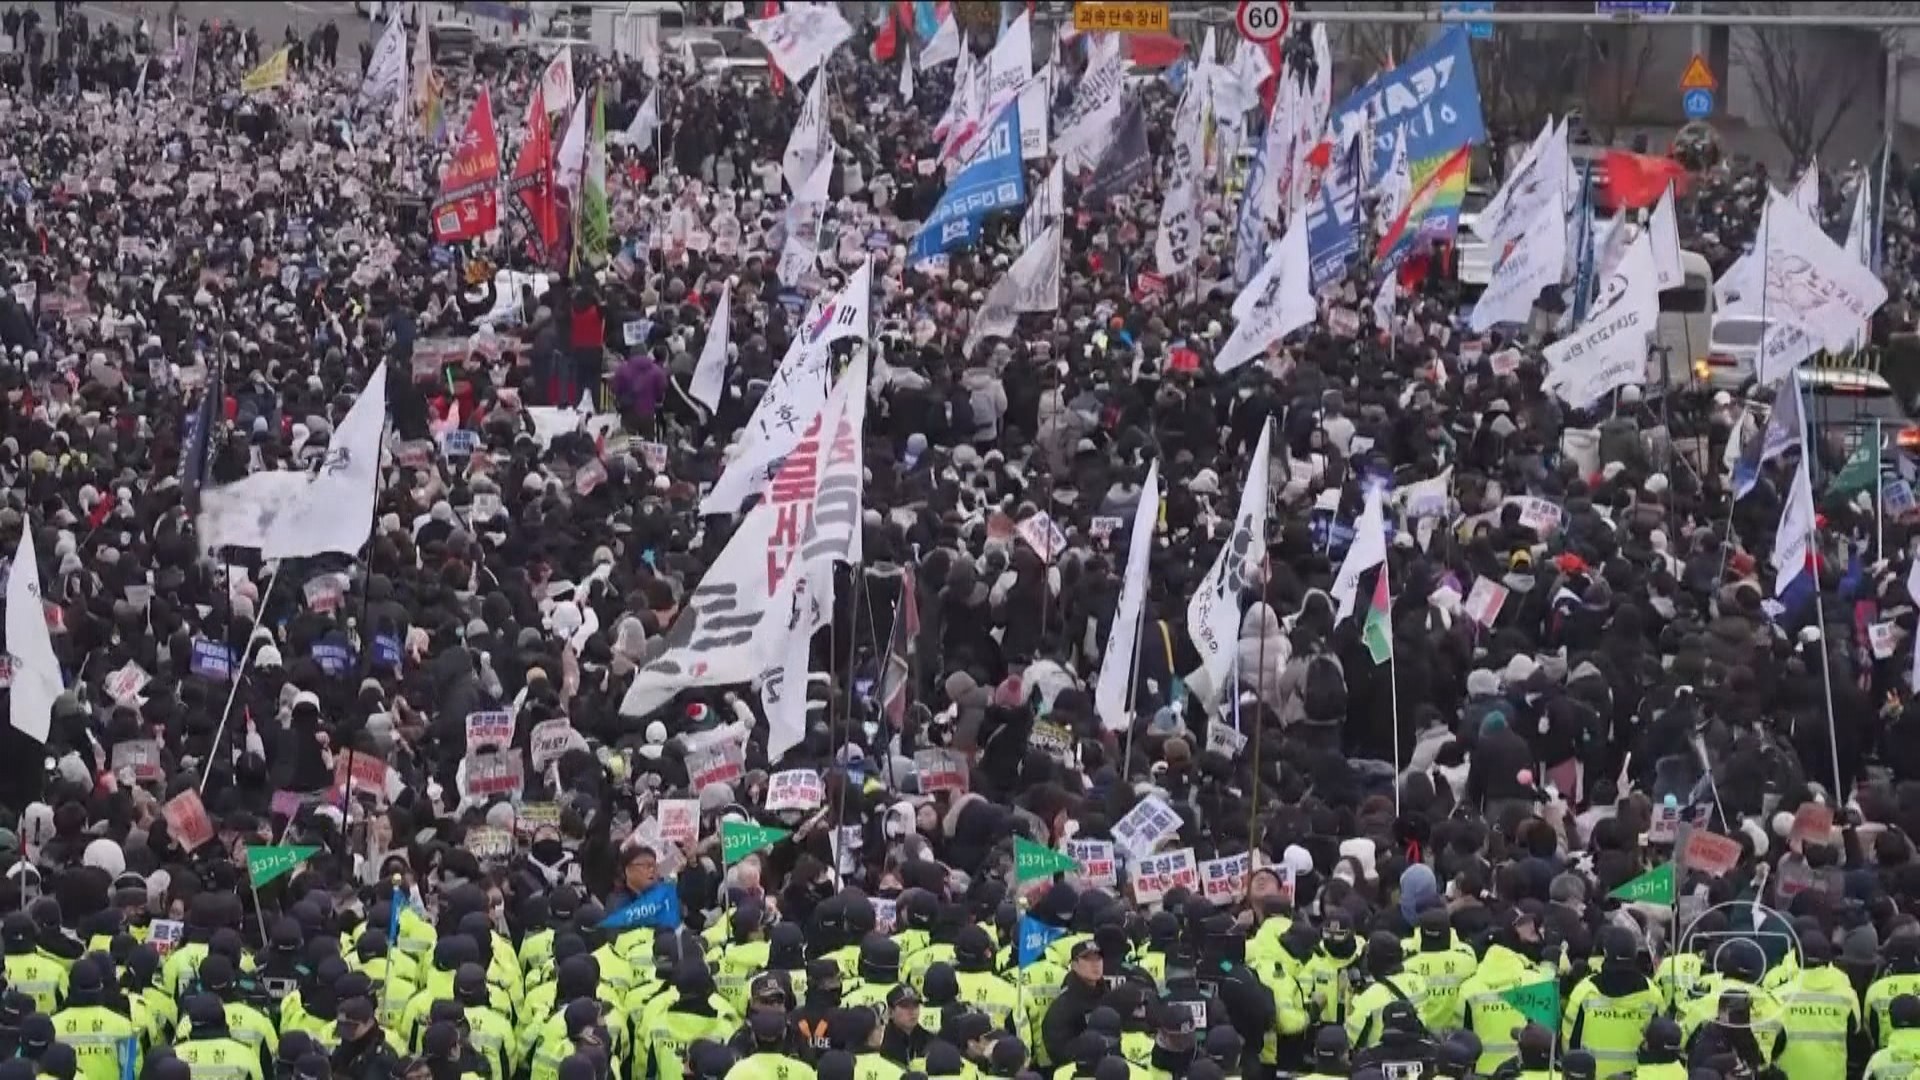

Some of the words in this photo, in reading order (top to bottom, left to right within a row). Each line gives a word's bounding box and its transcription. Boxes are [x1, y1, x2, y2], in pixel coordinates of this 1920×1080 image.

[1079, 10, 1162, 28] 과속단속장비
[1249, 7, 1278, 29] 60
[251, 851, 298, 874] 33기-3
[1018, 852, 1060, 868] 33기-1
[1631, 878, 1669, 896] 35기-1
[625, 900, 671, 924] 2300-1
[1593, 1009, 1645, 1021] POLICE
[1790, 1006, 1841, 1017] POLICE
[66, 1018, 103, 1034] 경찰
[809, 1035, 831, 1049] LICE
[77, 1046, 113, 1057] LICE
[187, 1047, 226, 1063] 경찰
